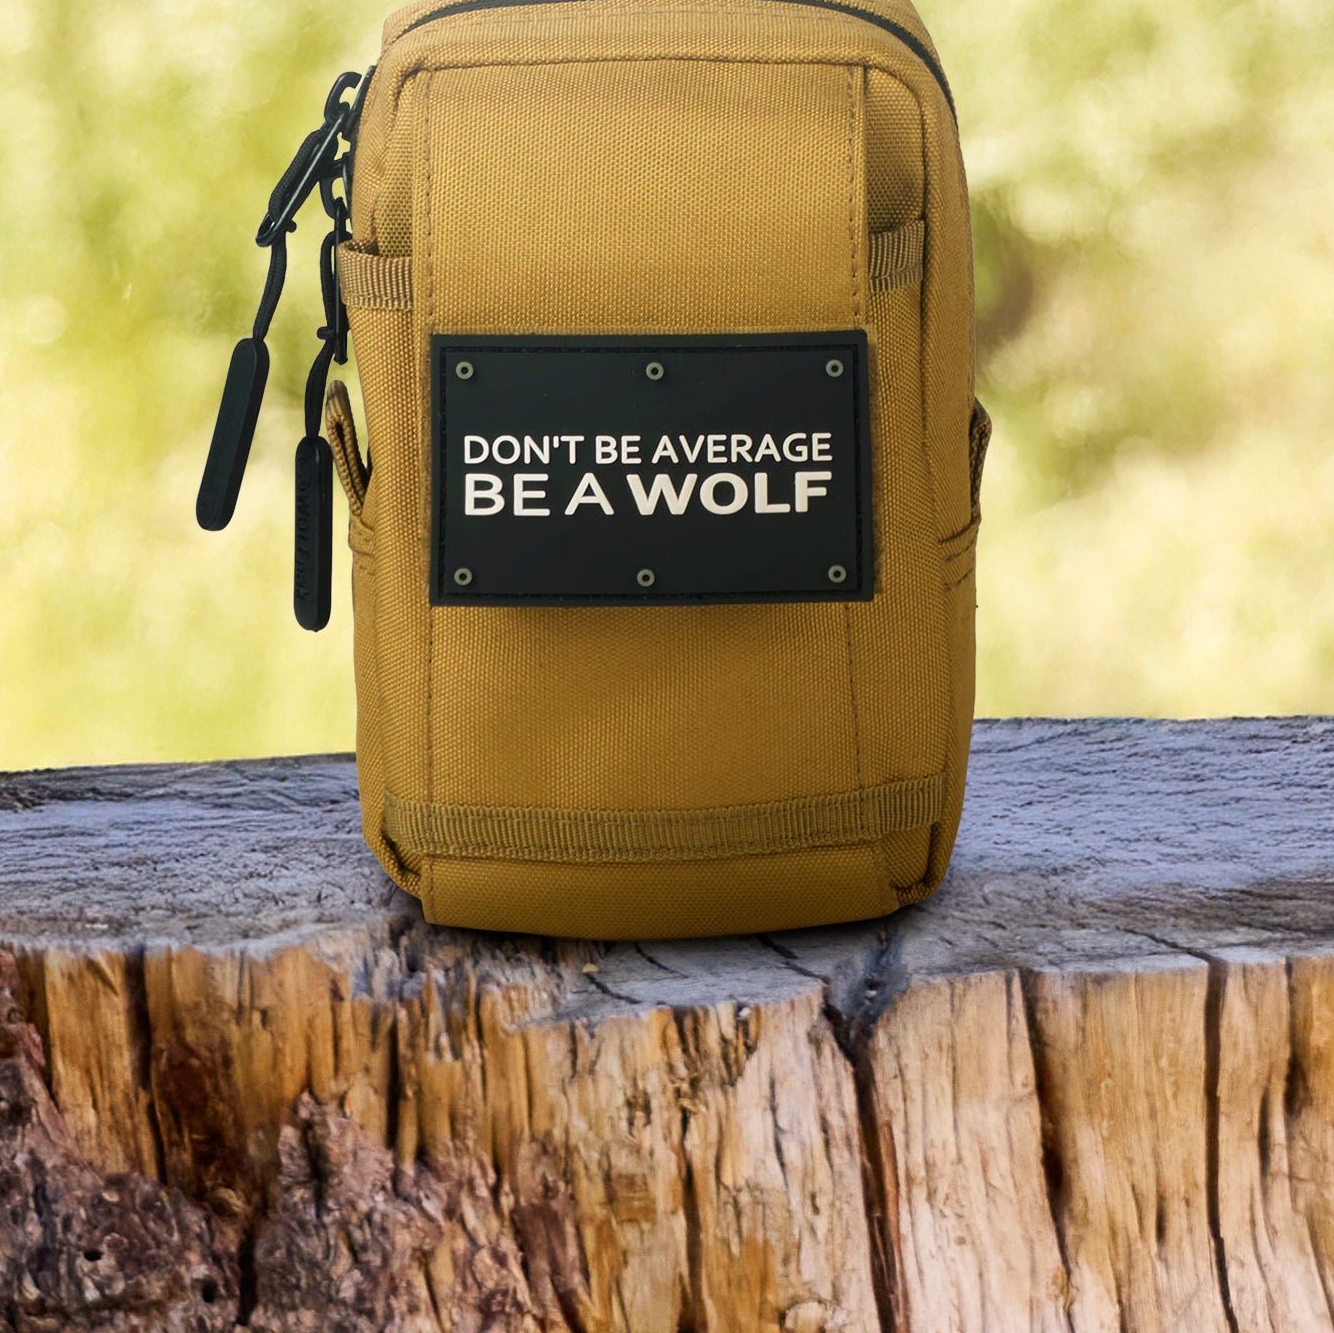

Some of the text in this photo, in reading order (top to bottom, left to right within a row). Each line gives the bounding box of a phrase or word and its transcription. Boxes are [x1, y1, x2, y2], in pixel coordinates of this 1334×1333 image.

[463, 432, 833, 465] DON'T BE AVERAGE
[464, 471, 833, 517] BE A WOLF
